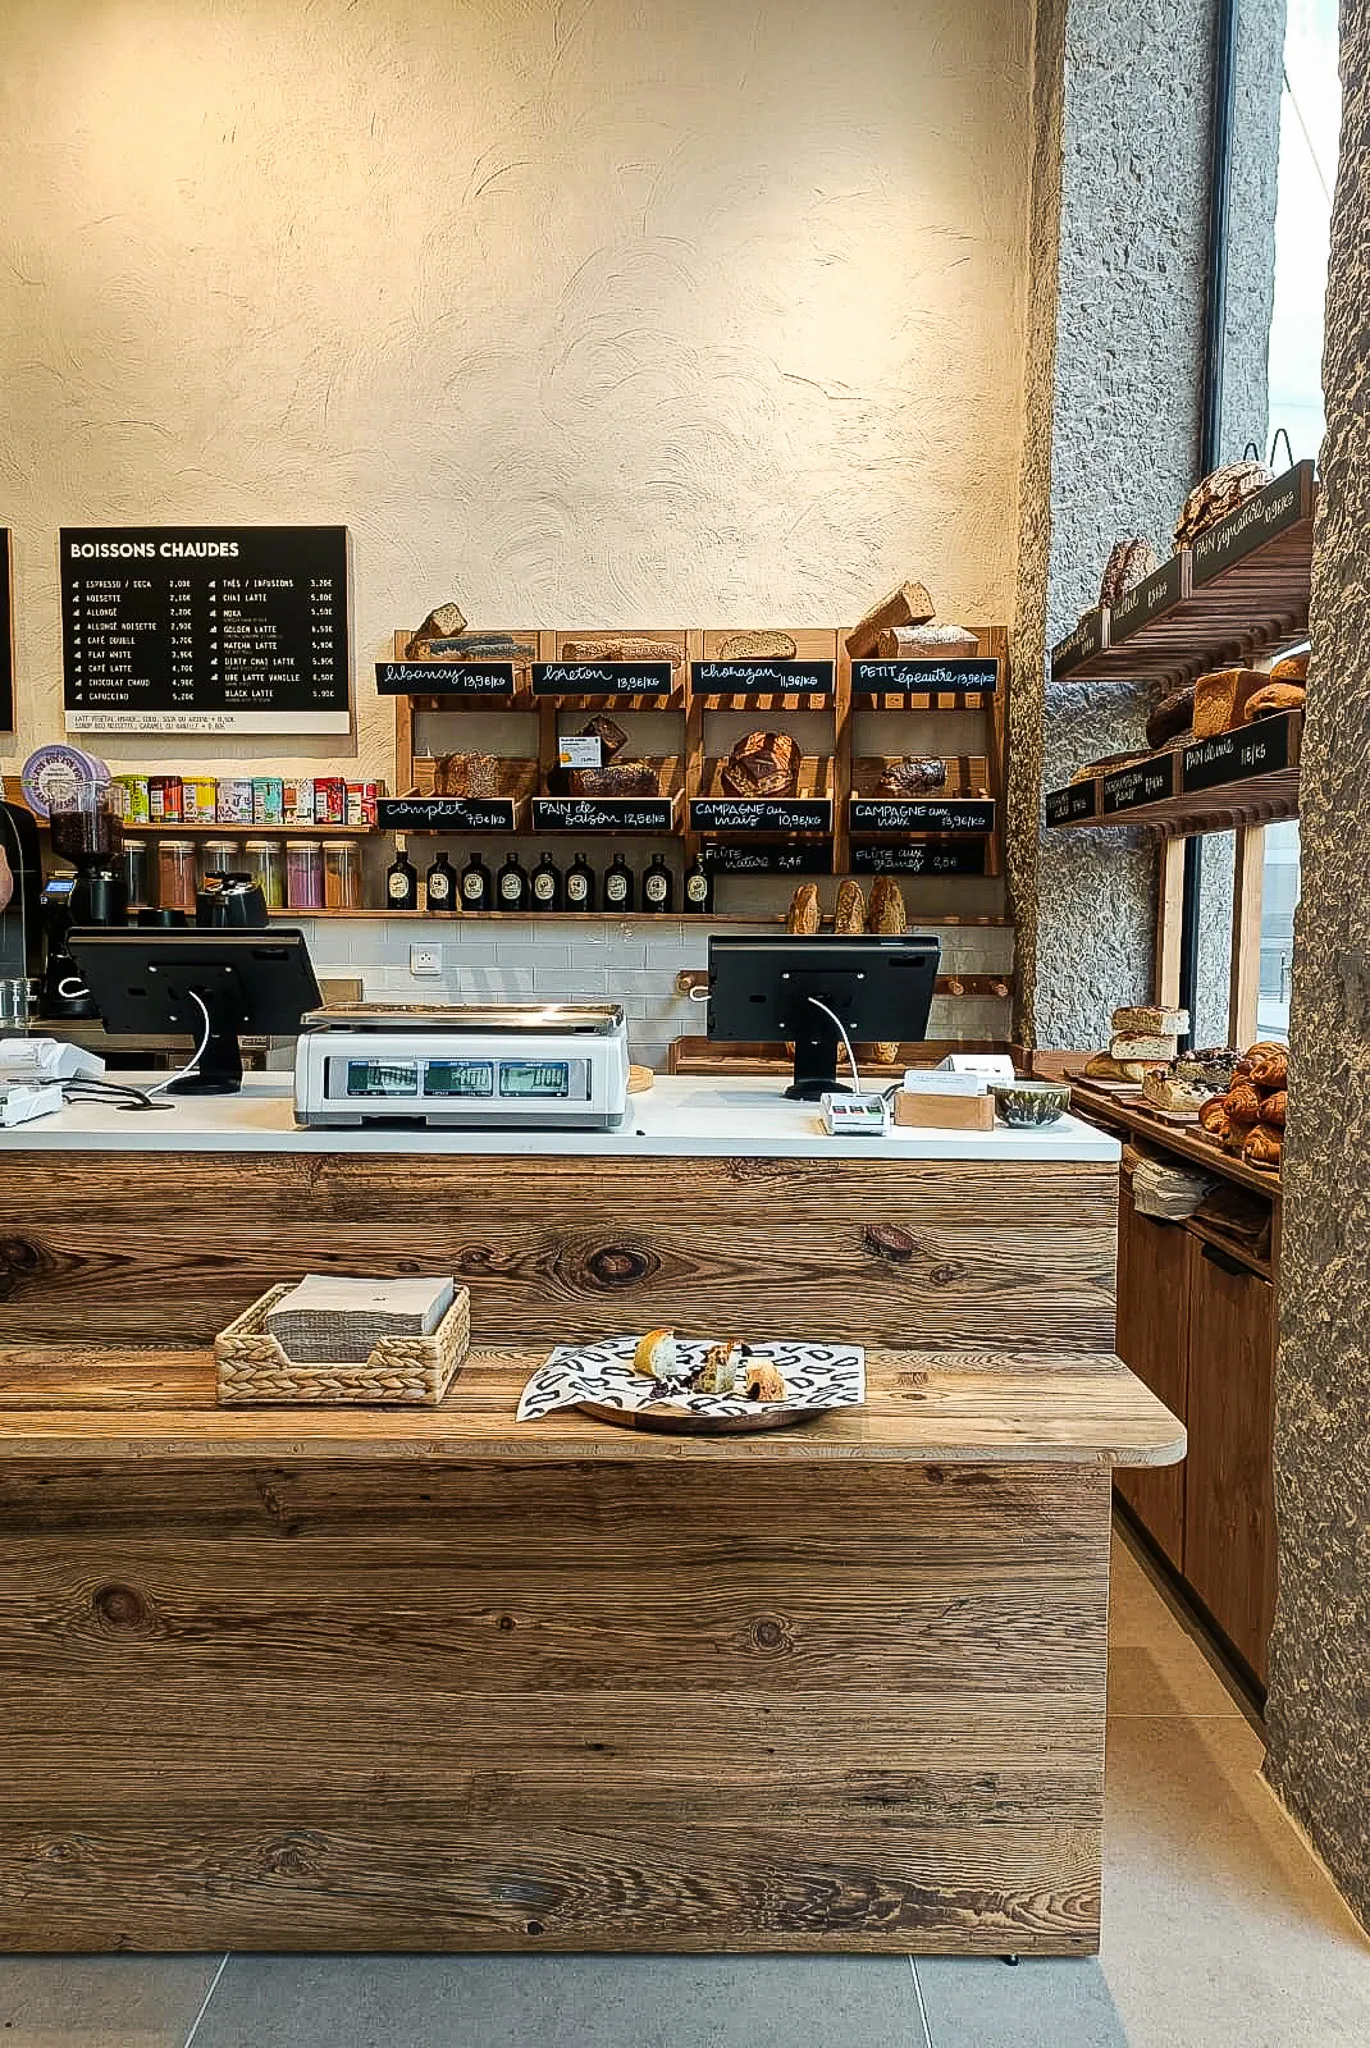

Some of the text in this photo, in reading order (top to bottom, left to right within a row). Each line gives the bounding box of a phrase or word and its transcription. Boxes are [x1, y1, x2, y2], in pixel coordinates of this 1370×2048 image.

[71, 542, 239, 558] BOISSONS CHAUDES
[245, 593, 267, 602] LATTE
[254, 625, 277, 634] LATTE
[223, 641, 251, 650] MATCHA
[255, 641, 278, 650] LATTE
[88, 650, 105, 659] FLAT
[109, 650, 132, 659] WHITE
[273, 657, 296, 666] LATTE
[110, 664, 133, 673] LATTE
[860, 665, 897, 678] PETIT
[242, 673, 265, 682] LATTE
[88, 679, 123, 687] CHOCOLAT
[251, 689, 274, 698] LATTE
[386, 801, 467, 820] complet
[539, 801, 596, 815] PAIN de
[695, 803, 787, 816] CAMPAGNE au
[855, 805, 951, 818] CAMPAGNE aux
[565, 812, 621, 826] saison
[898, 849, 925, 858] aux
